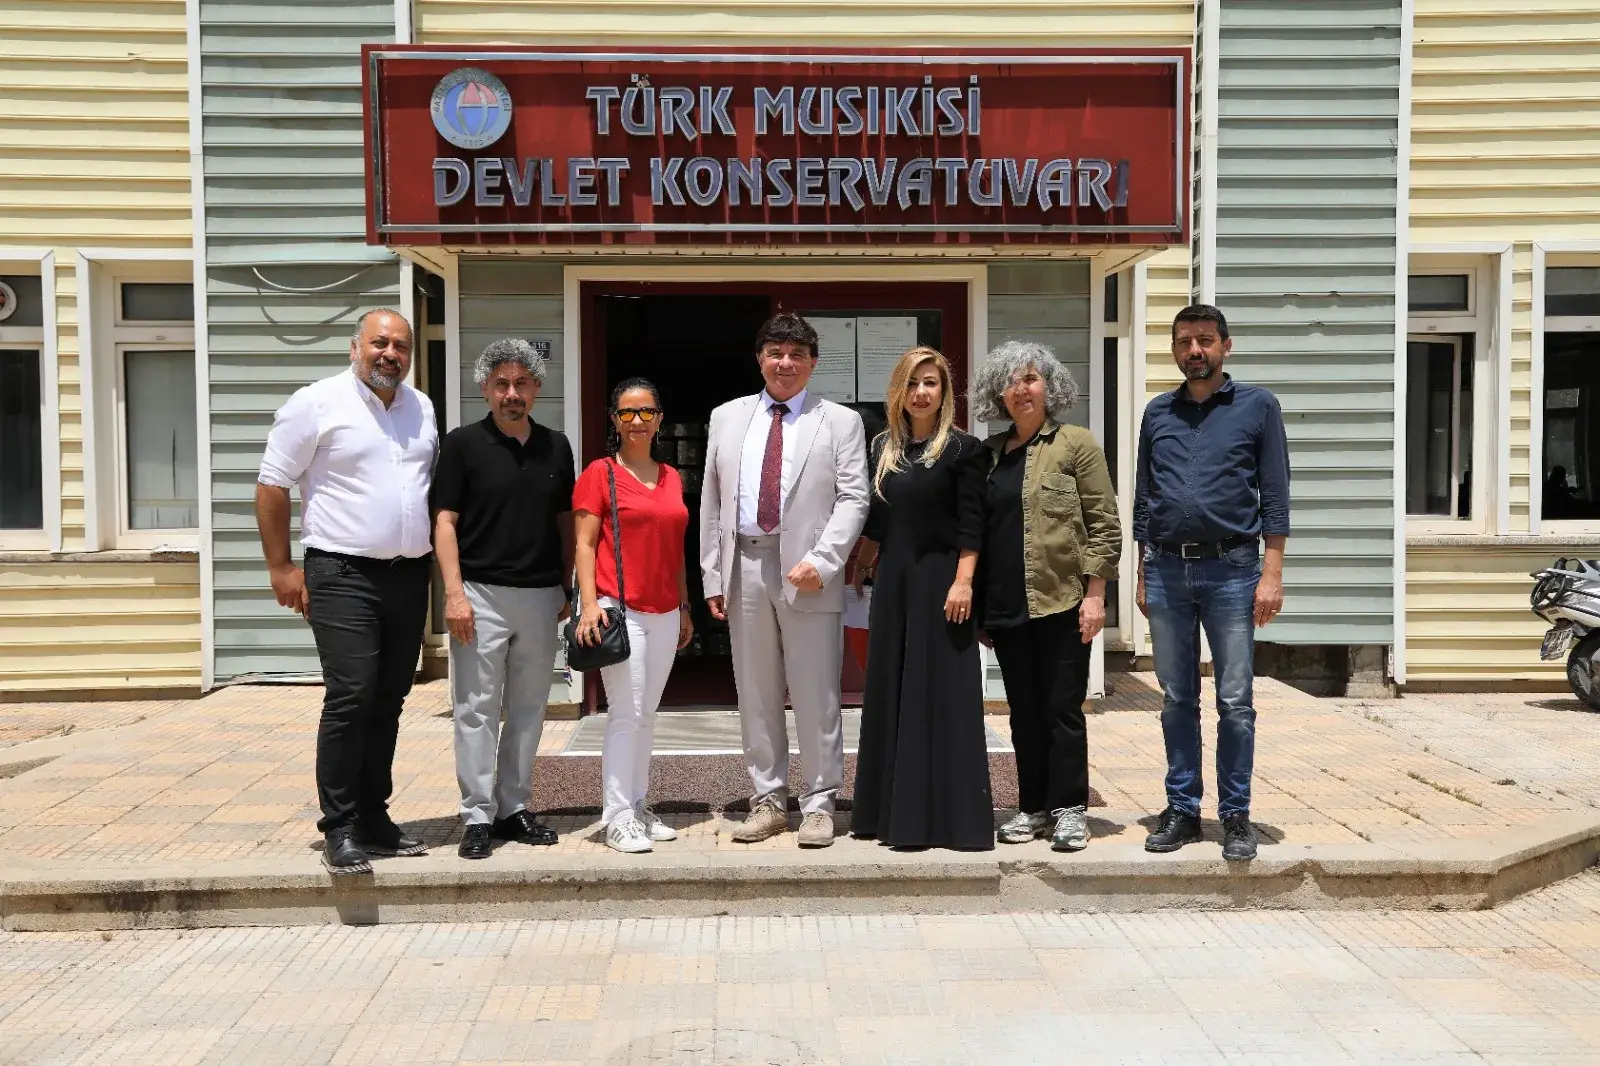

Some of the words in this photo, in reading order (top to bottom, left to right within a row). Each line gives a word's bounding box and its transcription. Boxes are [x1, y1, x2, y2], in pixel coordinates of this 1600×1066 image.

[586, 73, 736, 141] TÜRK
[754, 74, 981, 137] MUSIKİSİ
[432, 157, 631, 207] DEVLET
[650, 157, 1130, 212] KONSERVATUVARI
